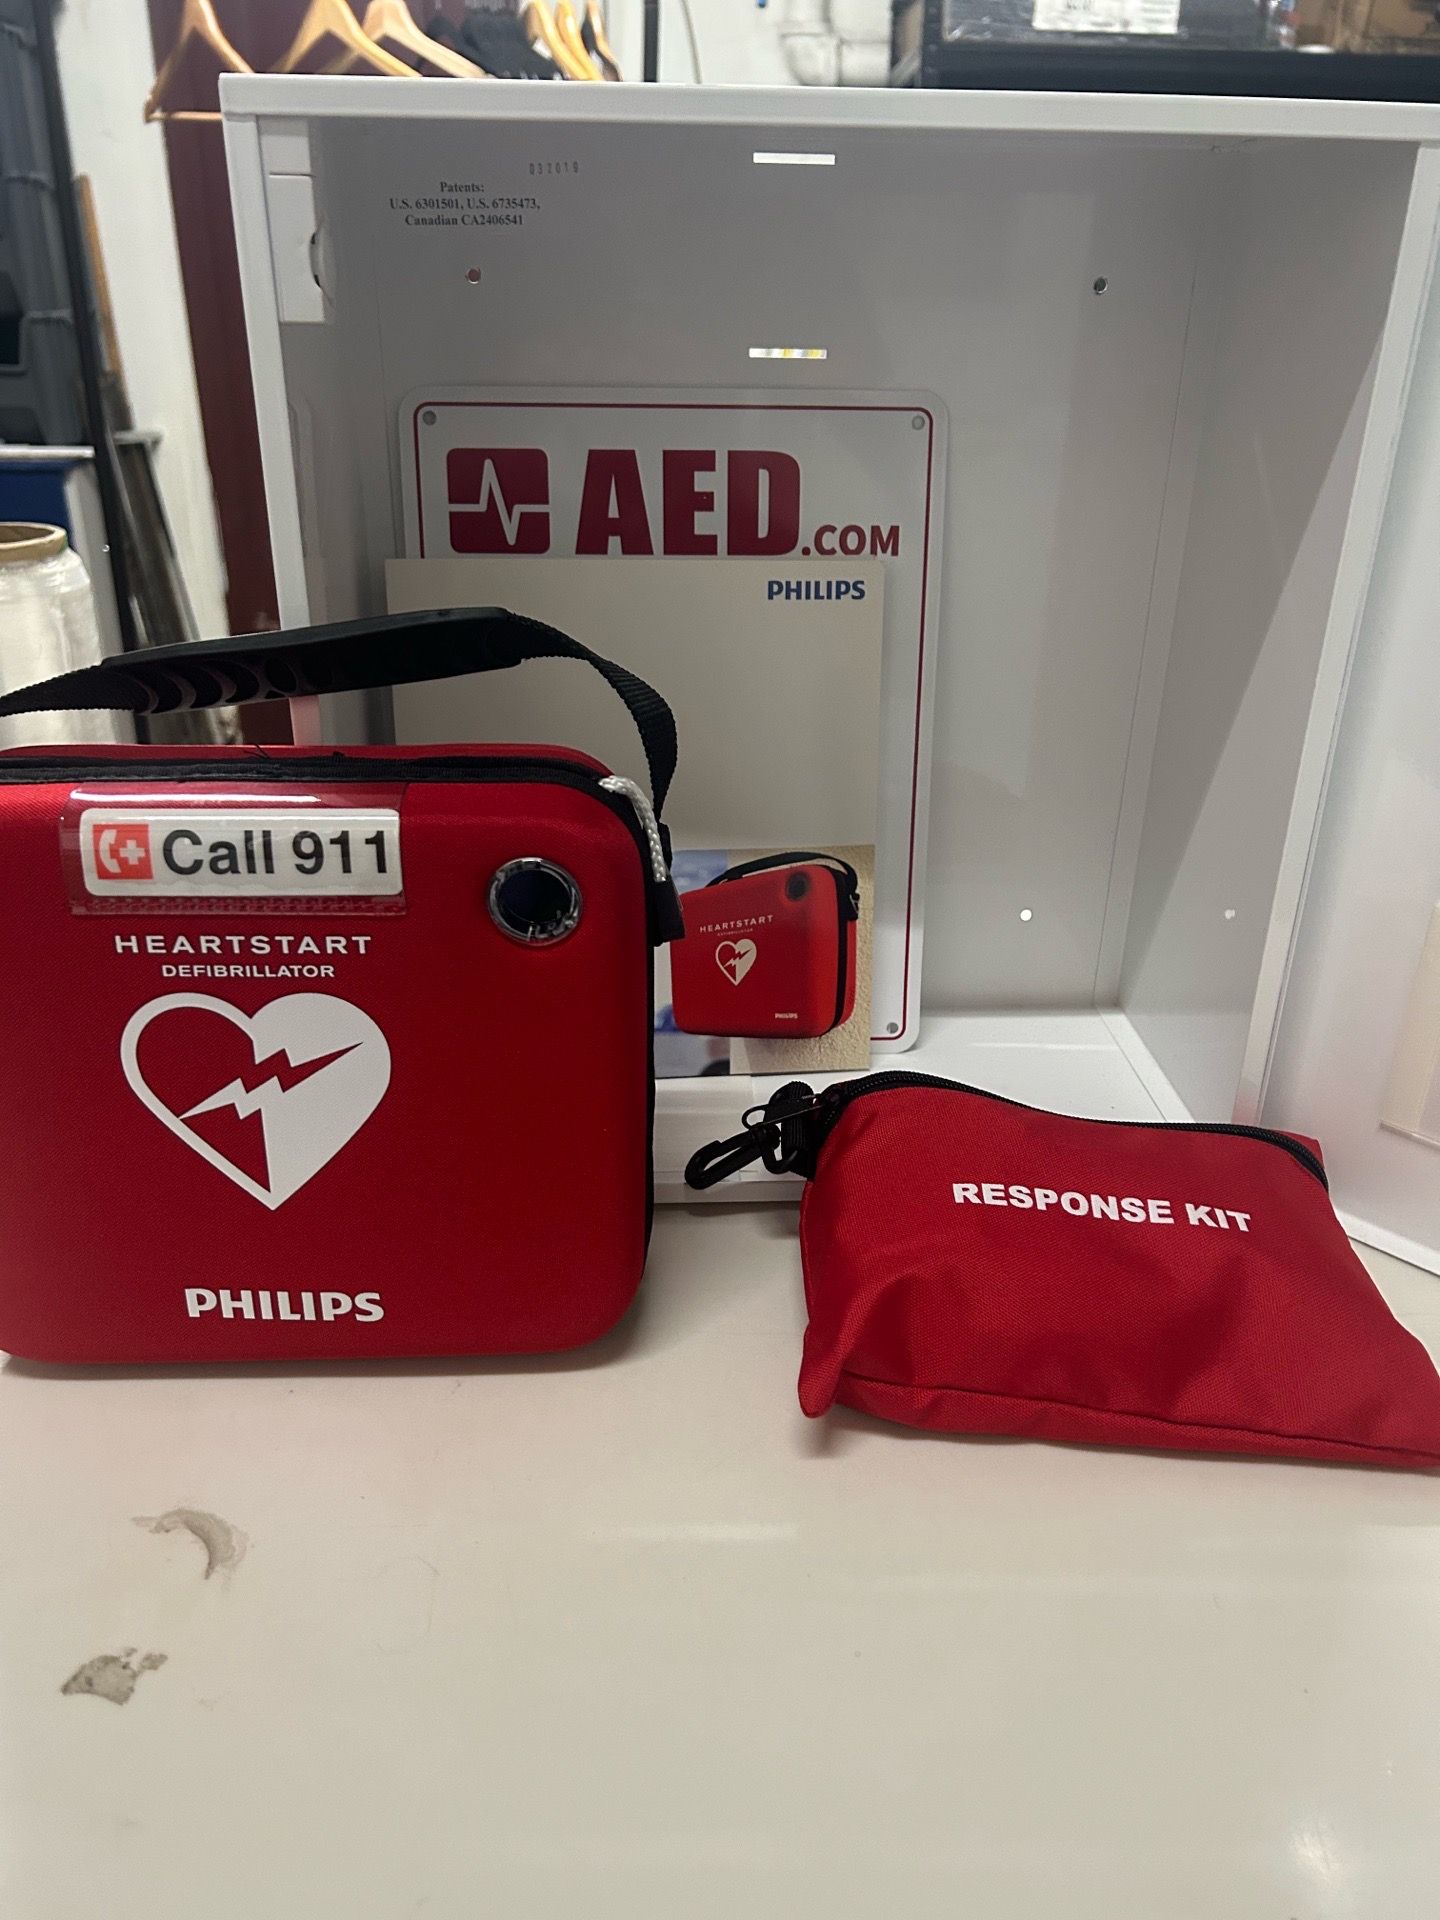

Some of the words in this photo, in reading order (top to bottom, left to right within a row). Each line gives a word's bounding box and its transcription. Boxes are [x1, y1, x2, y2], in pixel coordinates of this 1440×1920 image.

[439, 181, 485, 193] Patents:
[389, 198, 412, 210] U.S.
[415, 198, 464, 211] 6301501,
[467, 198, 490, 210] U.S.
[492, 198, 541, 211] 6735473,
[404, 214, 458, 226] Canadian
[461, 214, 524, 226] CA2406541
[767, 580, 866, 601] PHILIPS
[162, 828, 275, 876] Call
[291, 829, 388, 875] 911
[699, 914, 774, 933] HEARTSTART
[114, 934, 372, 955] HEARTSTART
[161, 964, 335, 978] DEFIBRILLATOR
[952, 1183, 1175, 1224] RESPONSE
[1185, 1203, 1251, 1232] KIT
[184, 1287, 385, 1322] PHILIPS
